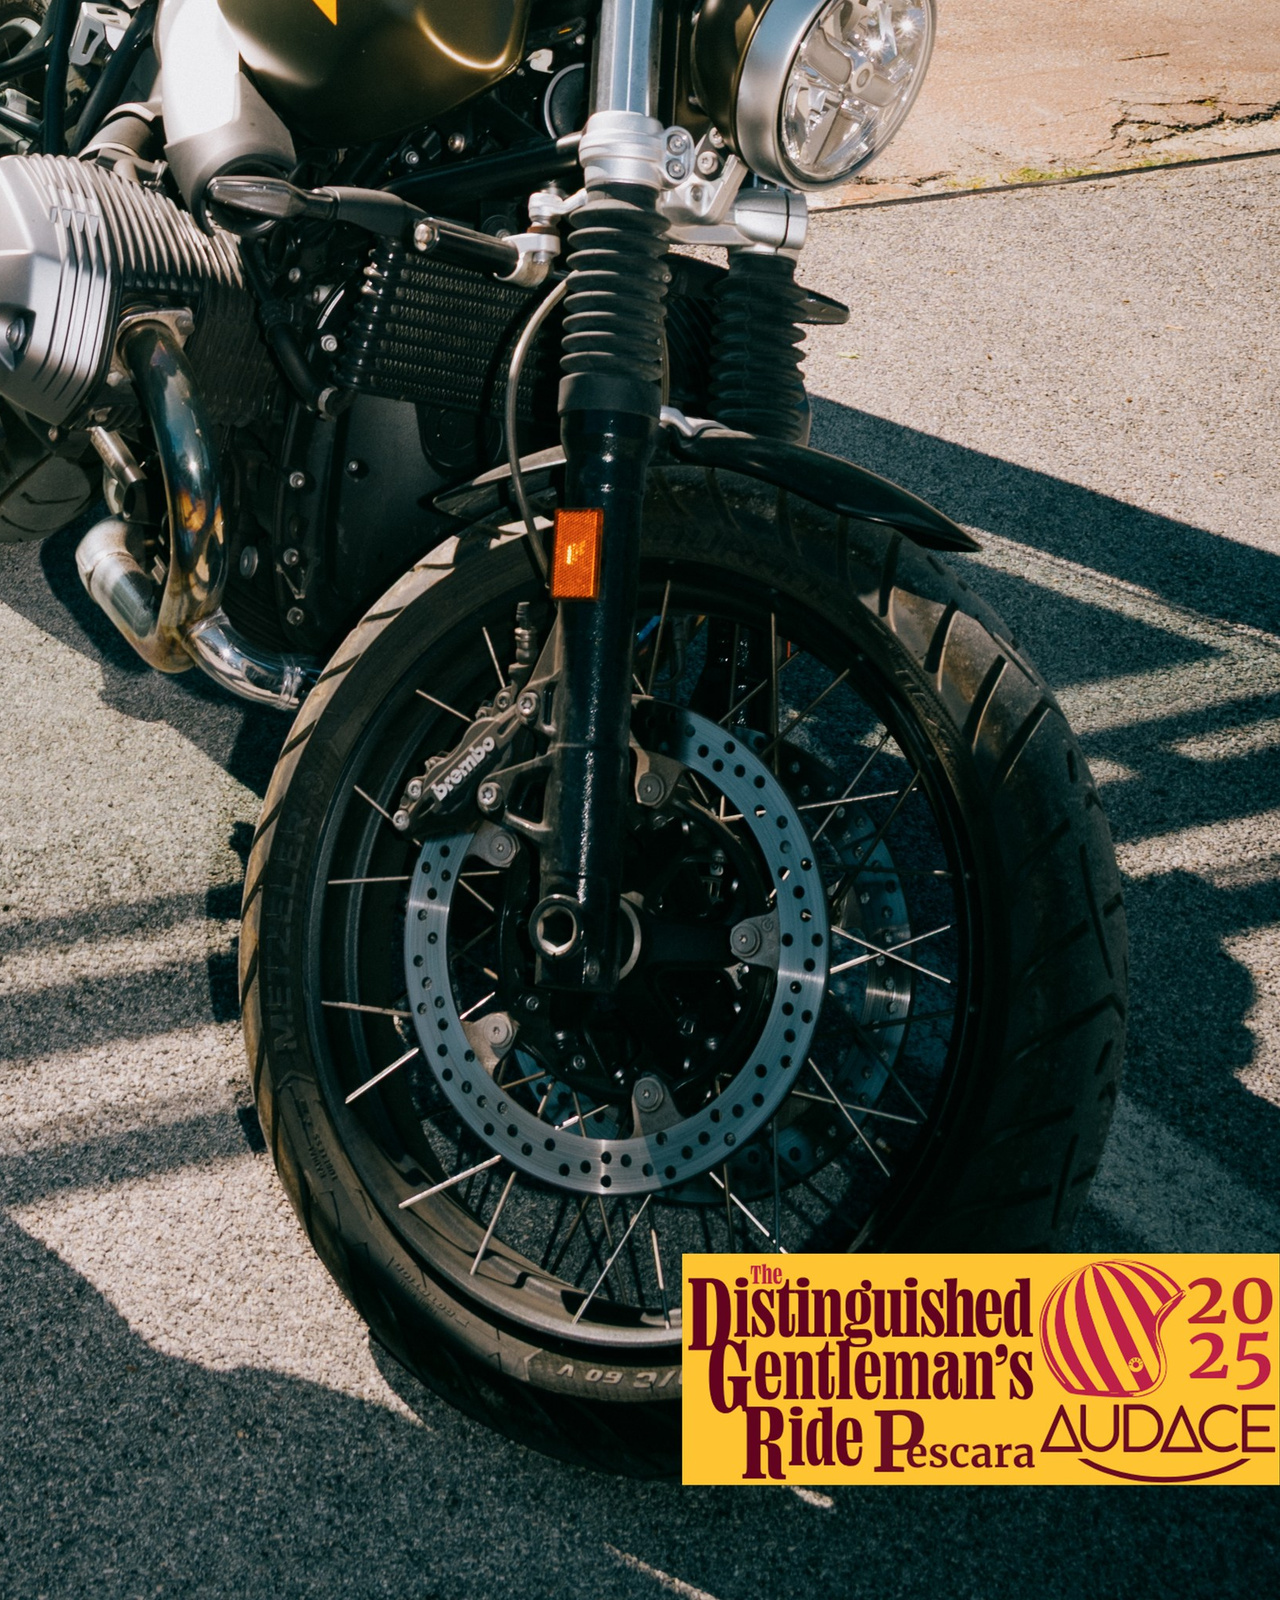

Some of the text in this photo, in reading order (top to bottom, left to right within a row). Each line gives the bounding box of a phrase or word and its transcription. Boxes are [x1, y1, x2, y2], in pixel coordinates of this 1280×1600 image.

[431, 736, 496, 802] brembo
[264, 810, 312, 1053] METZELER
[556, 1363, 682, 1389] /C 60 V
